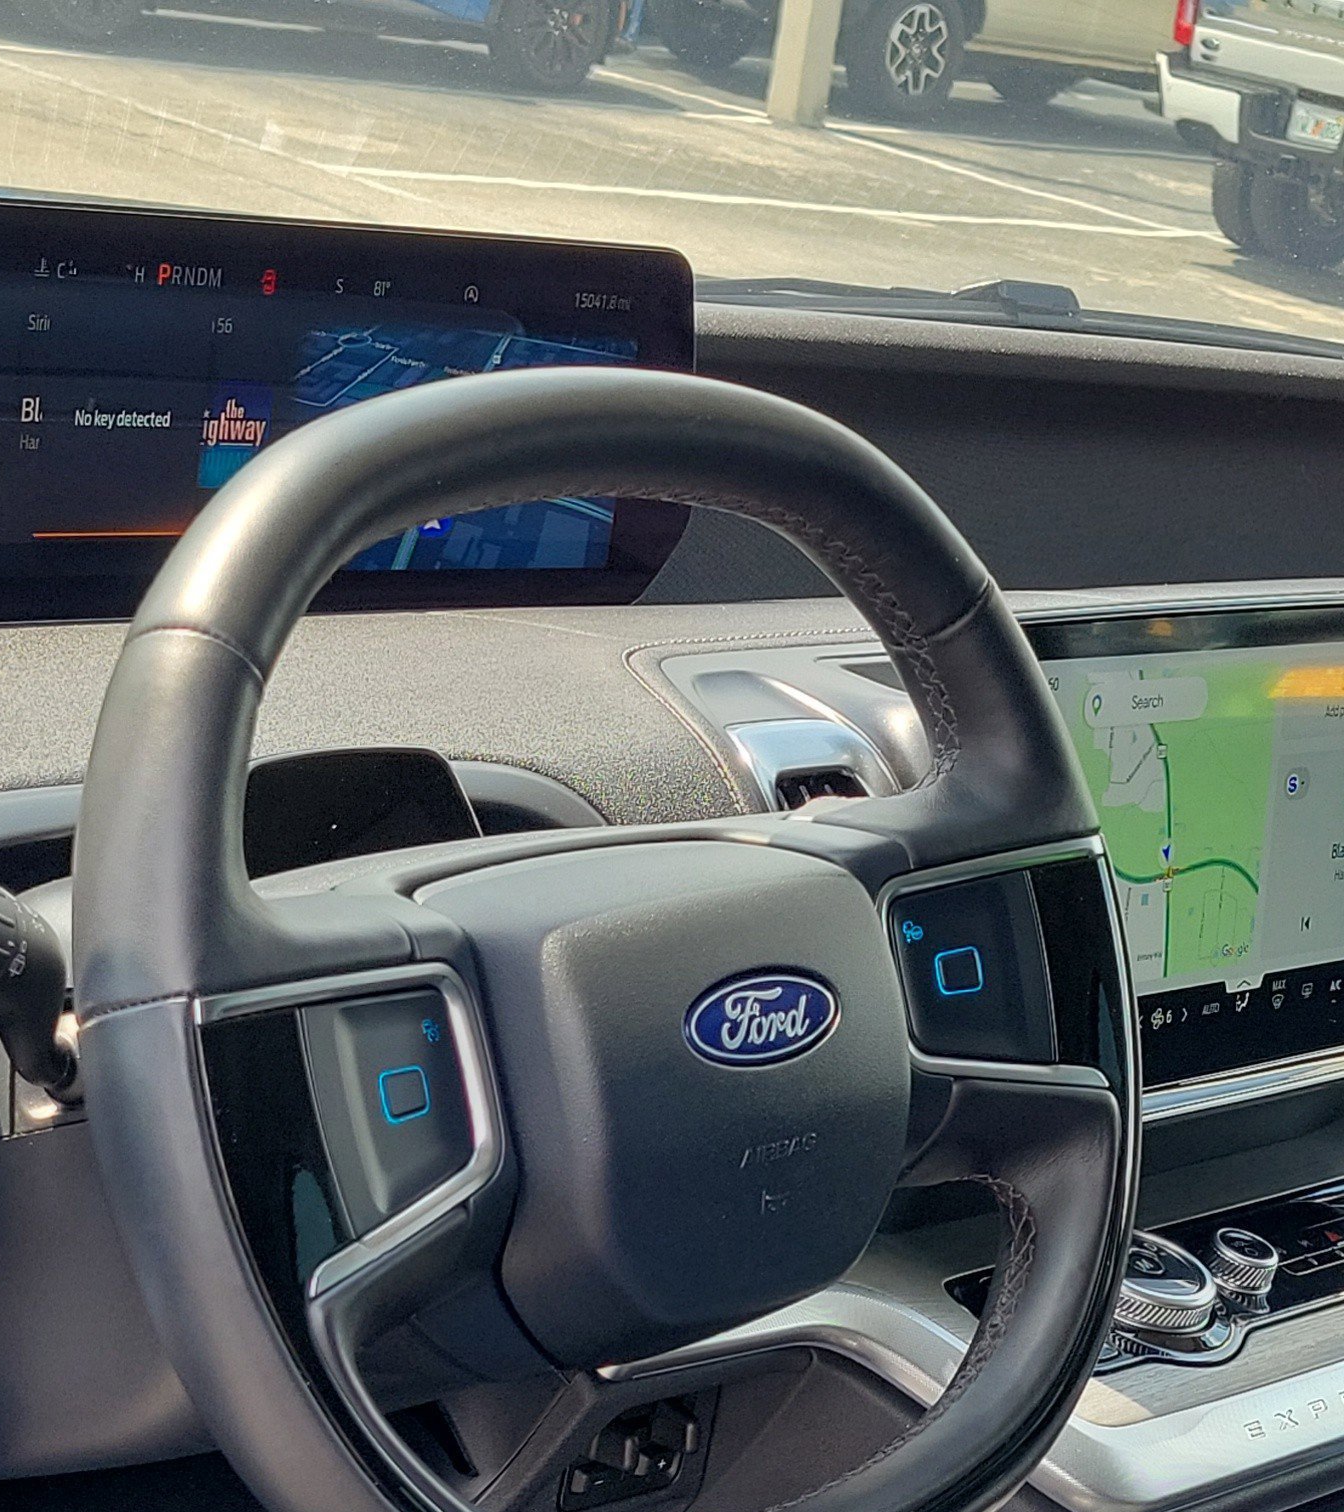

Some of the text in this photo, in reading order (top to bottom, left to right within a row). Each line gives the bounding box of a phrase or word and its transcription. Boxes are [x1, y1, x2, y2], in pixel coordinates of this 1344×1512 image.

[74, 409, 171, 430] No key detected
[202, 410, 267, 447] ighway
[1131, 694, 1164, 711] Search
[721, 986, 810, 1050] Ford
